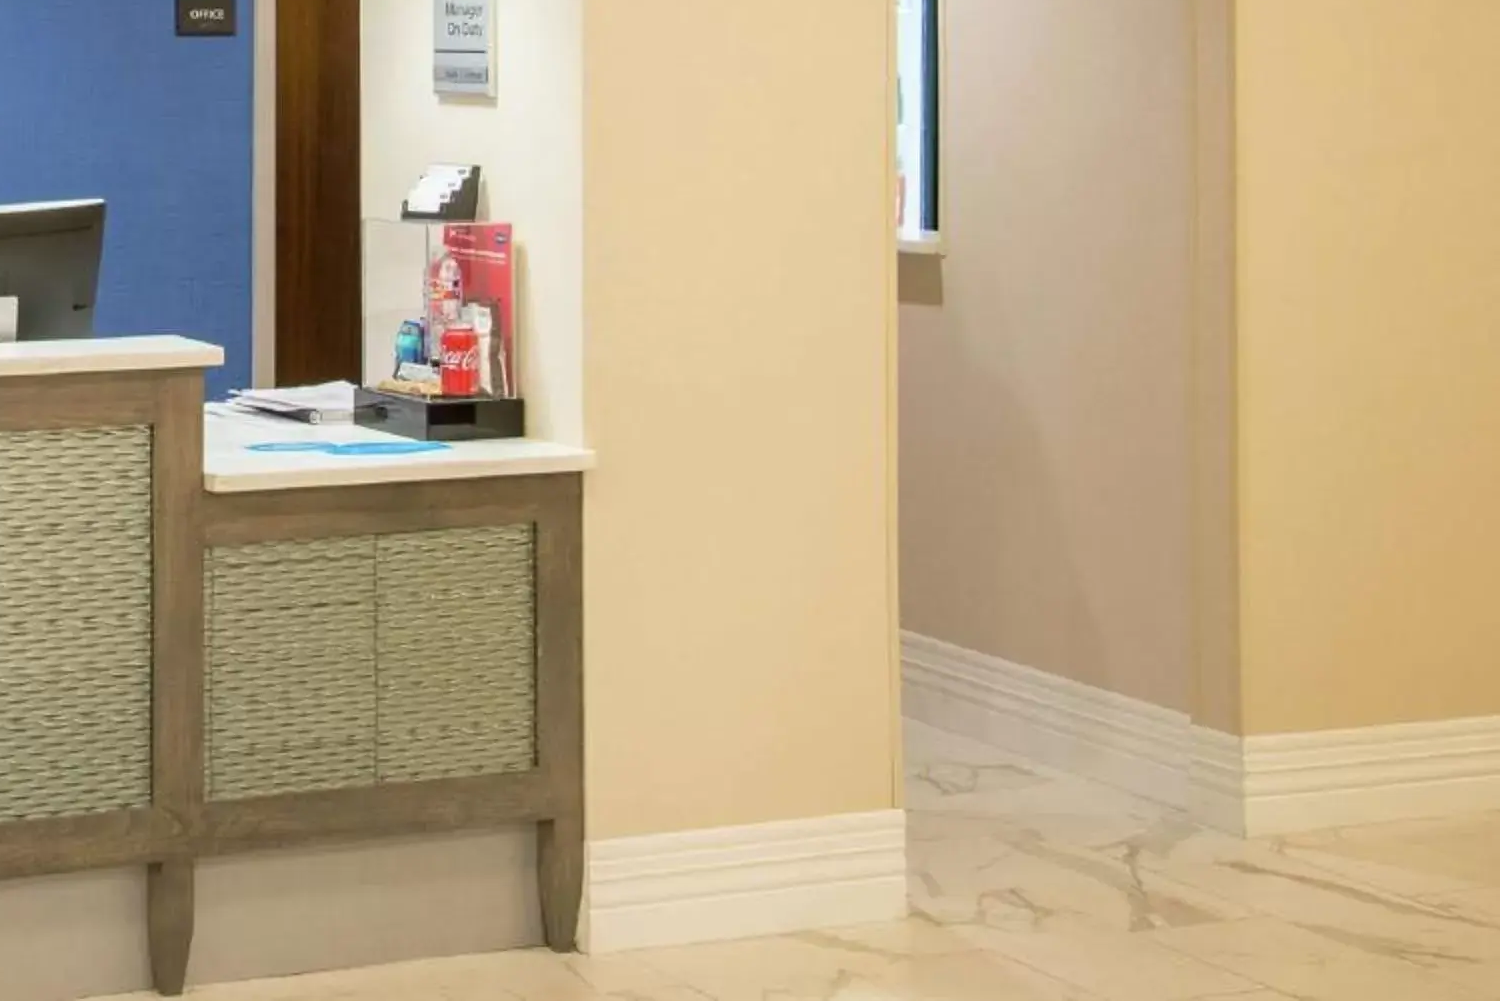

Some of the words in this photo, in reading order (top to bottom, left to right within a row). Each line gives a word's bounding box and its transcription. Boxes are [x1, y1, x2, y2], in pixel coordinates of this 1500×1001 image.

[189, 8, 225, 20] OFFICE
[445, 2, 483, 20] Manager
[447, 22, 461, 36] On
[463, 22, 483, 37] Duty
